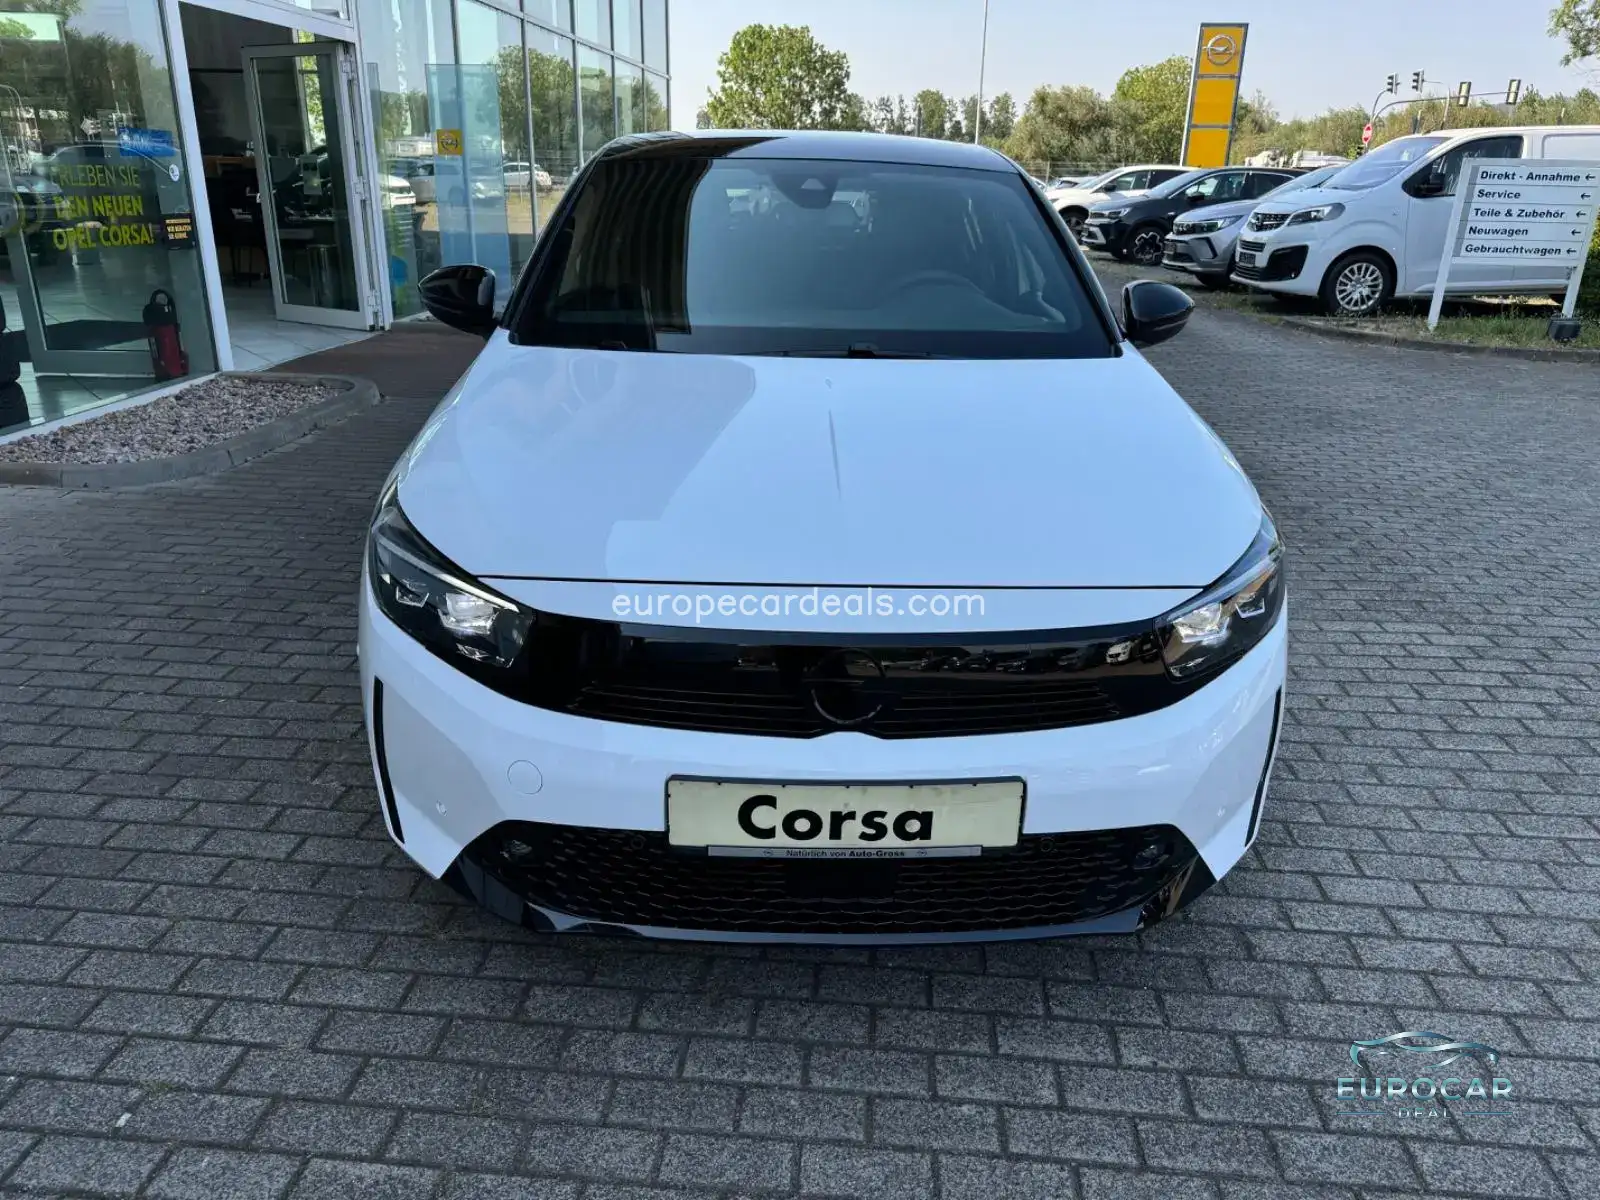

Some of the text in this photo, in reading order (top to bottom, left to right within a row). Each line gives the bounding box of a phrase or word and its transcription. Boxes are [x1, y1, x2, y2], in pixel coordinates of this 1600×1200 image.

[119, 165, 140, 187] SIE
[1480, 170, 1516, 181] Direkt
[1525, 171, 1581, 182] Annahme
[1477, 189, 1521, 199] Service
[92, 195, 143, 216] NEUEN
[1474, 208, 1565, 219] Teile & Zubehör
[99, 221, 155, 247] CORSA!
[1468, 226, 1529, 238] Neuwagen
[1465, 244, 1562, 257] Gebrauchtwagen
[737, 794, 934, 842] Corsa
[786, 849, 828, 858] Natürlich
[829, 849, 847, 858] von
